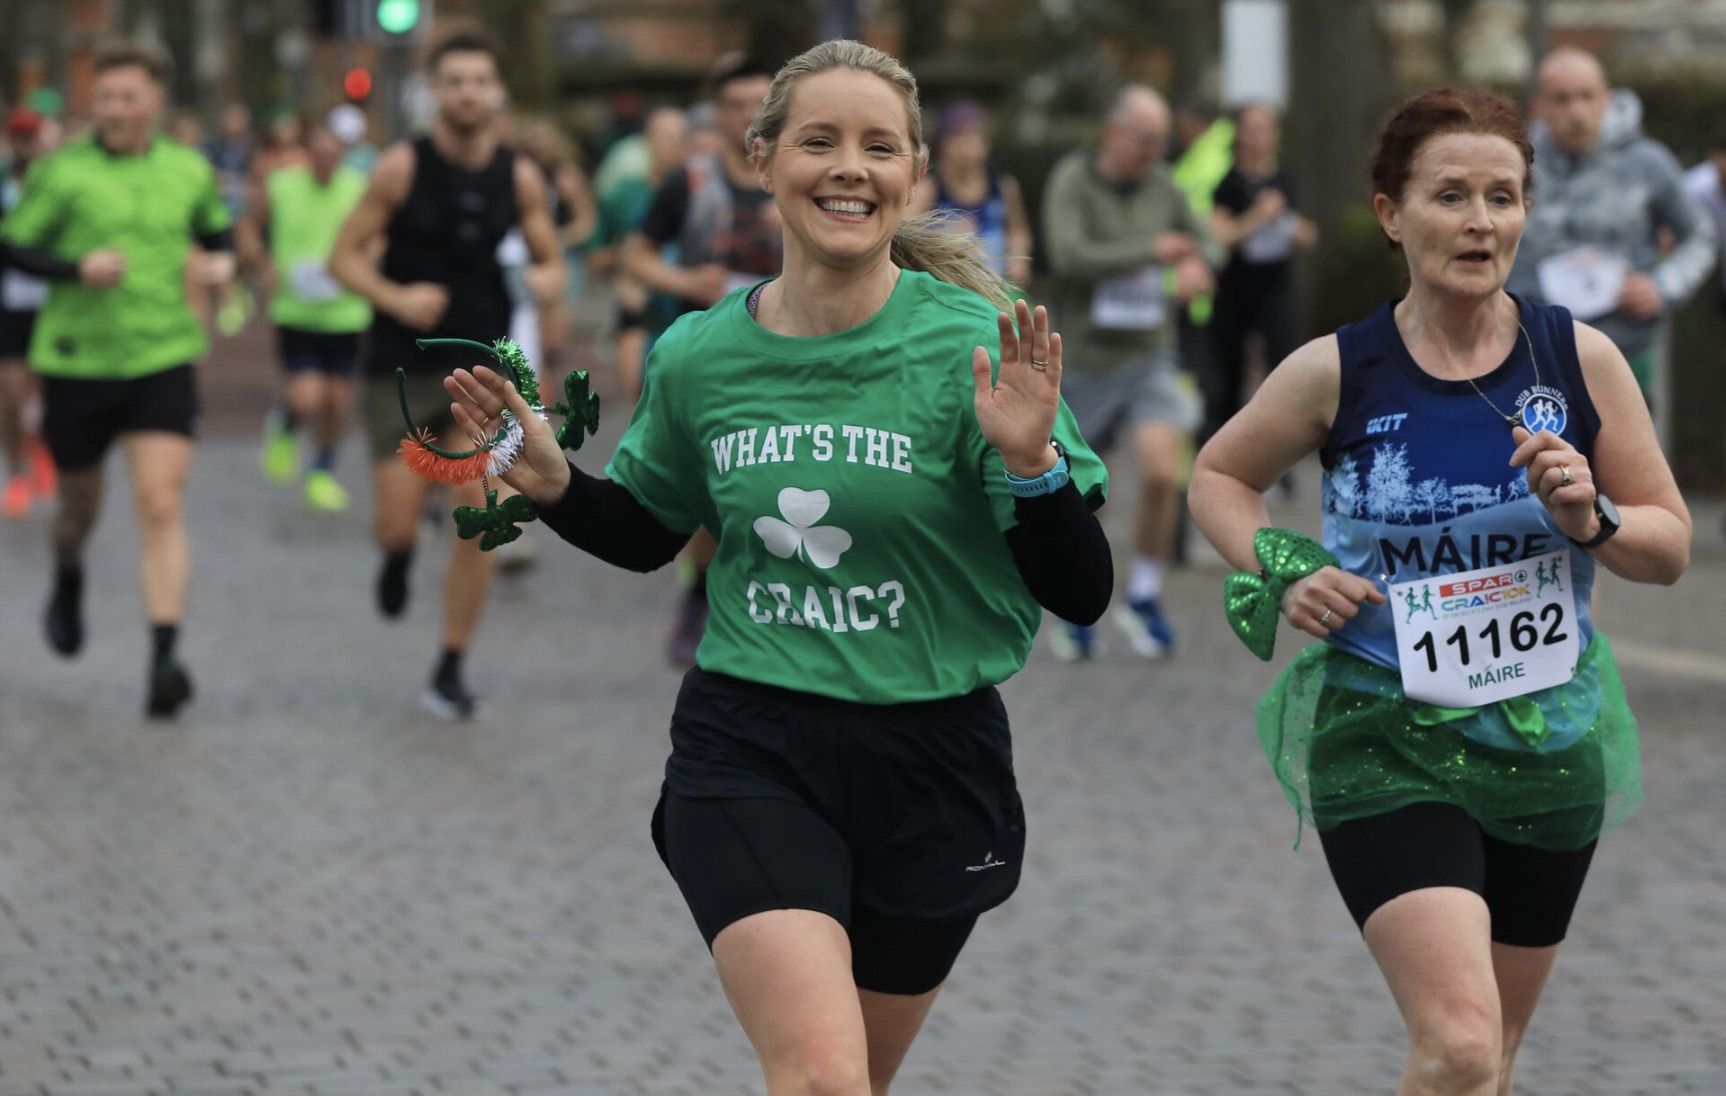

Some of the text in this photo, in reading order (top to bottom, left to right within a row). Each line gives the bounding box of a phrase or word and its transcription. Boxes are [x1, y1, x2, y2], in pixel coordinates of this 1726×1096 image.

[1514, 389, 1531, 407] DUB
[711, 424, 912, 475] WHAT'S THE
[1451, 573, 1512, 595] SPAR
[747, 580, 906, 633] CRAIC?
[1413, 602, 1568, 673] 11162
[1468, 662, 1526, 690] MÁIRE
